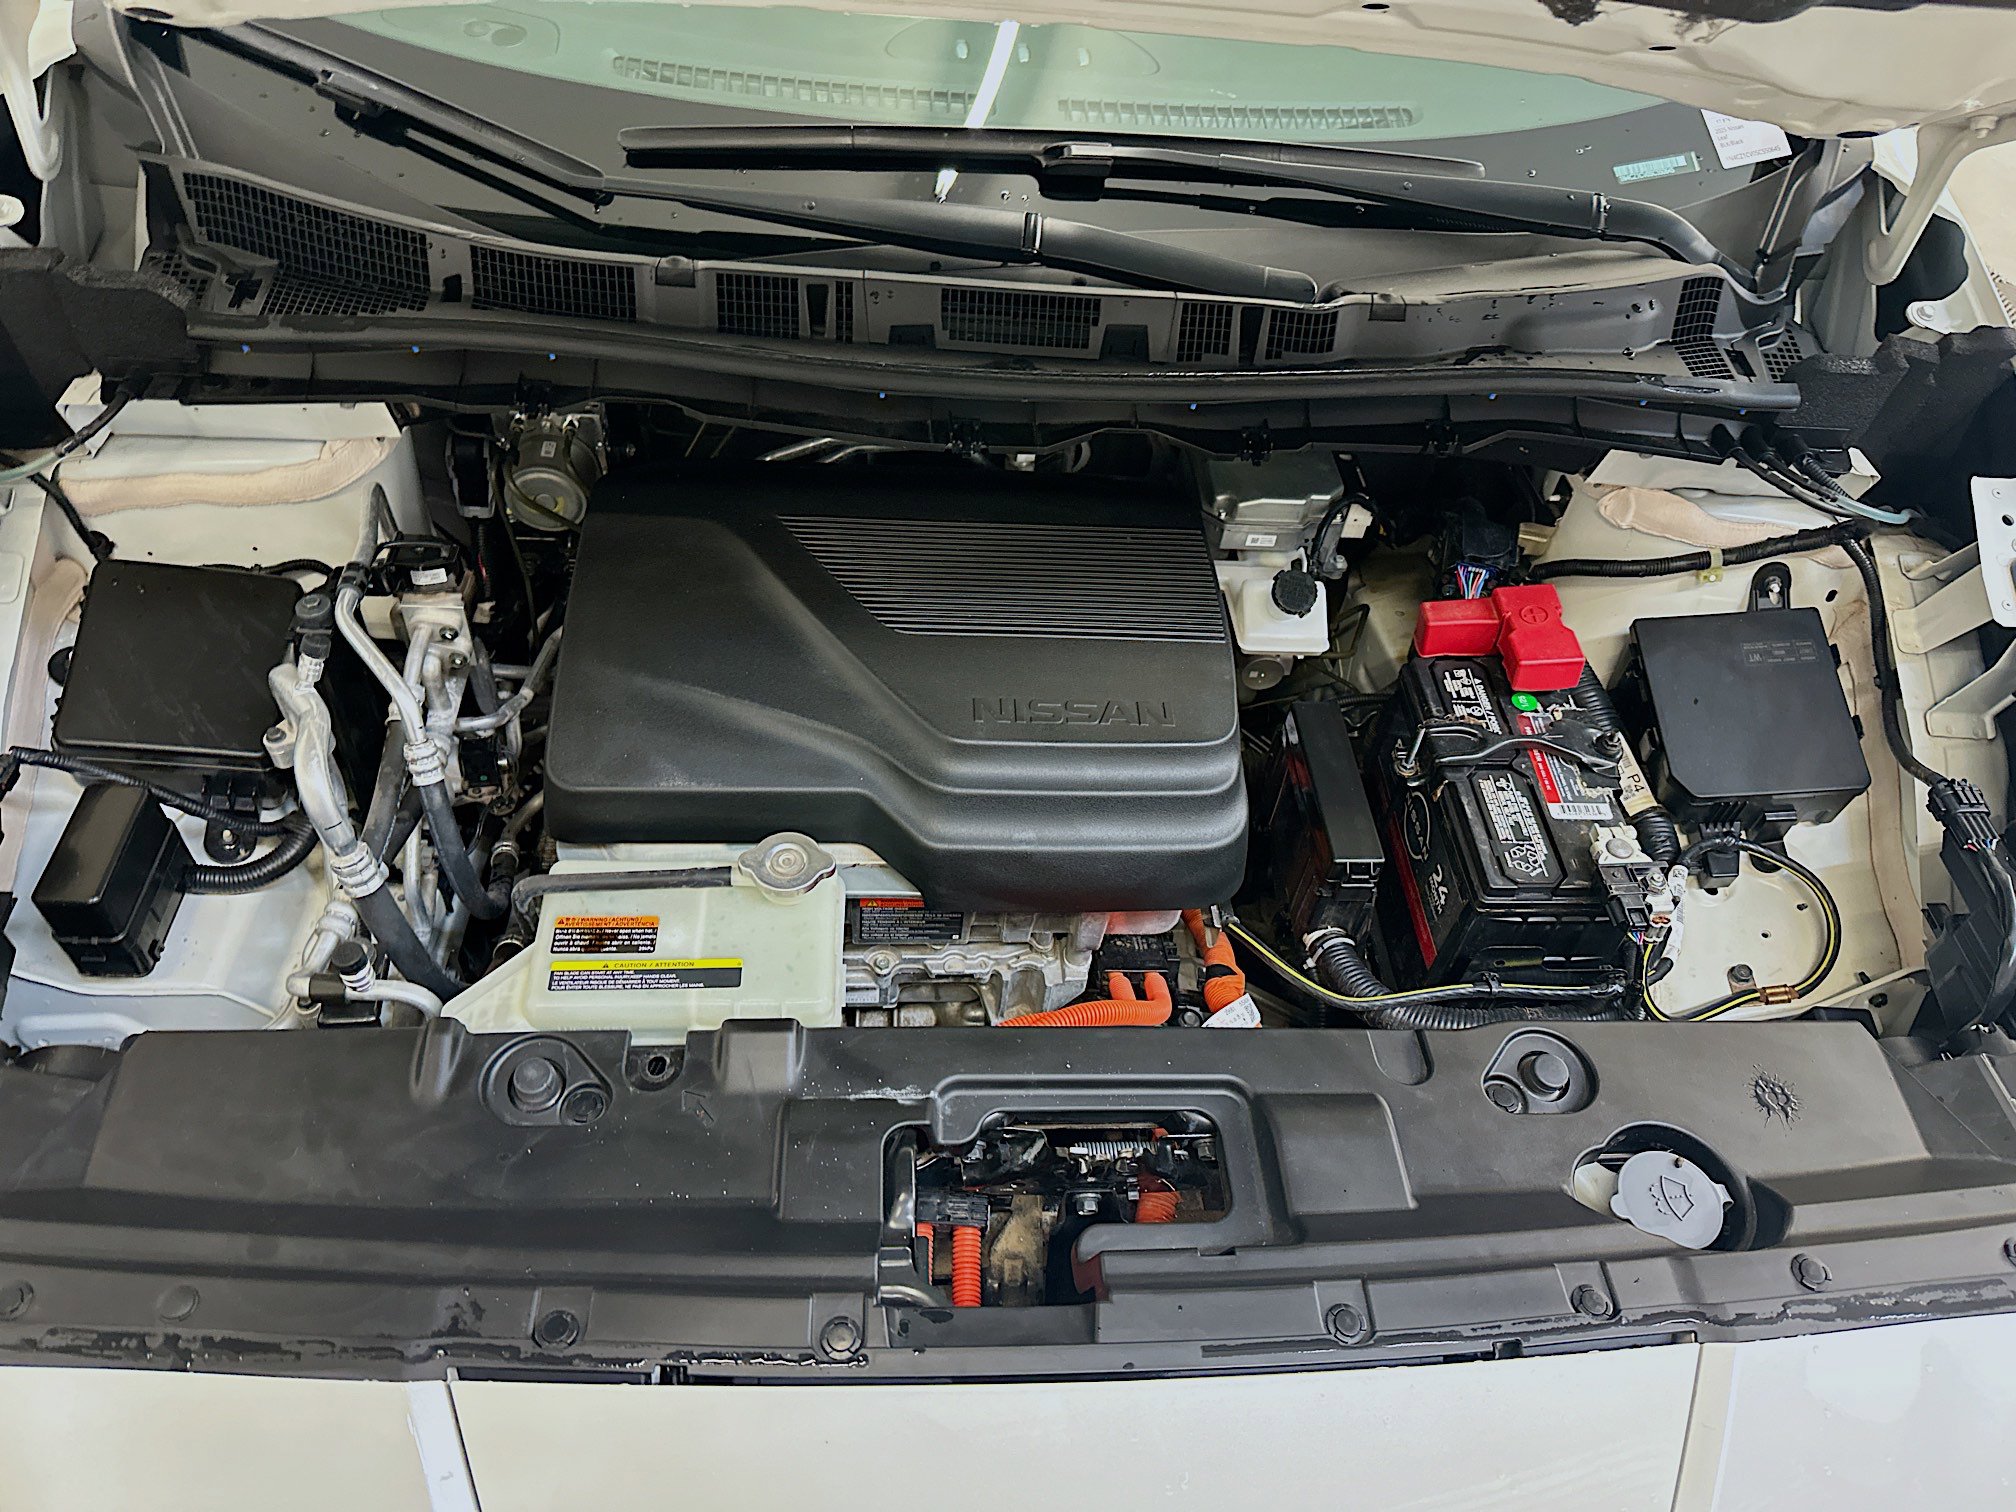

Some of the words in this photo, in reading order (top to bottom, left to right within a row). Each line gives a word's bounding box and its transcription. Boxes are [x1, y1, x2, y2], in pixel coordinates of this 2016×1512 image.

[972, 697, 1176, 728] NISSAN
[1476, 685, 1492, 710] DANGER
[1627, 773, 1645, 792] P4
[1405, 791, 1429, 861] NISSAN
[1432, 863, 1449, 906] 24
